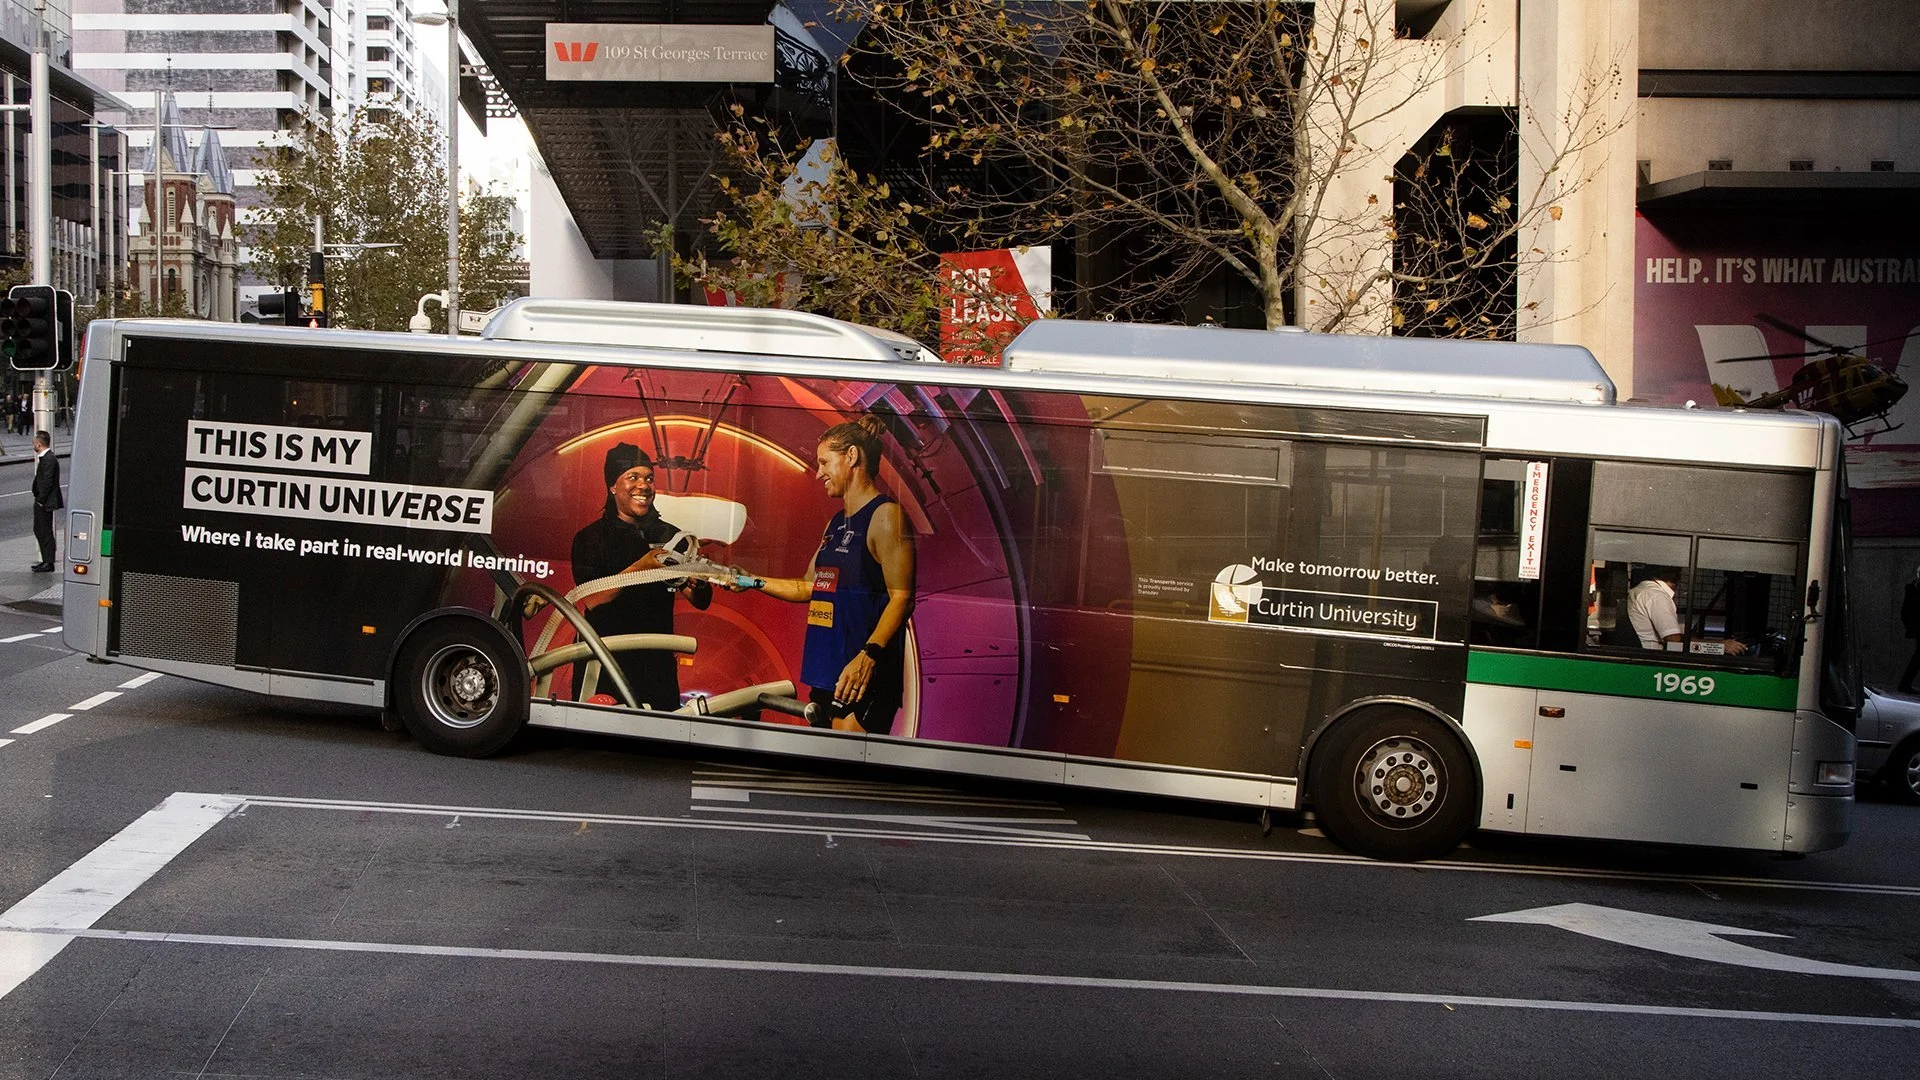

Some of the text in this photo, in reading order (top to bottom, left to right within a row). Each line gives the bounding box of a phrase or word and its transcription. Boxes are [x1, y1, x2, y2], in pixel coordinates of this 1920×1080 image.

[604, 46, 630, 60] 109
[633, 45, 649, 60] St
[652, 45, 710, 62] Georges
[713, 46, 768, 61] Terrace
[951, 267, 992, 294] FOR
[1646, 258, 1709, 284] HELP.
[1716, 258, 1757, 284] IT'S
[1762, 258, 1826, 284] WHAT
[951, 295, 1018, 324] LEASE
[194, 427, 361, 465] THIS IS MY
[191, 475, 485, 525] CURTIN UNIVERSE
[1526, 463, 1541, 565] EMERGENCY EXIT
[181, 525, 555, 579] Where I take part in real-world learning.
[1252, 556, 1440, 586] Make tomorrow better.
[1256, 598, 1417, 631] Curtin University
[1653, 672, 1715, 696] 1969
